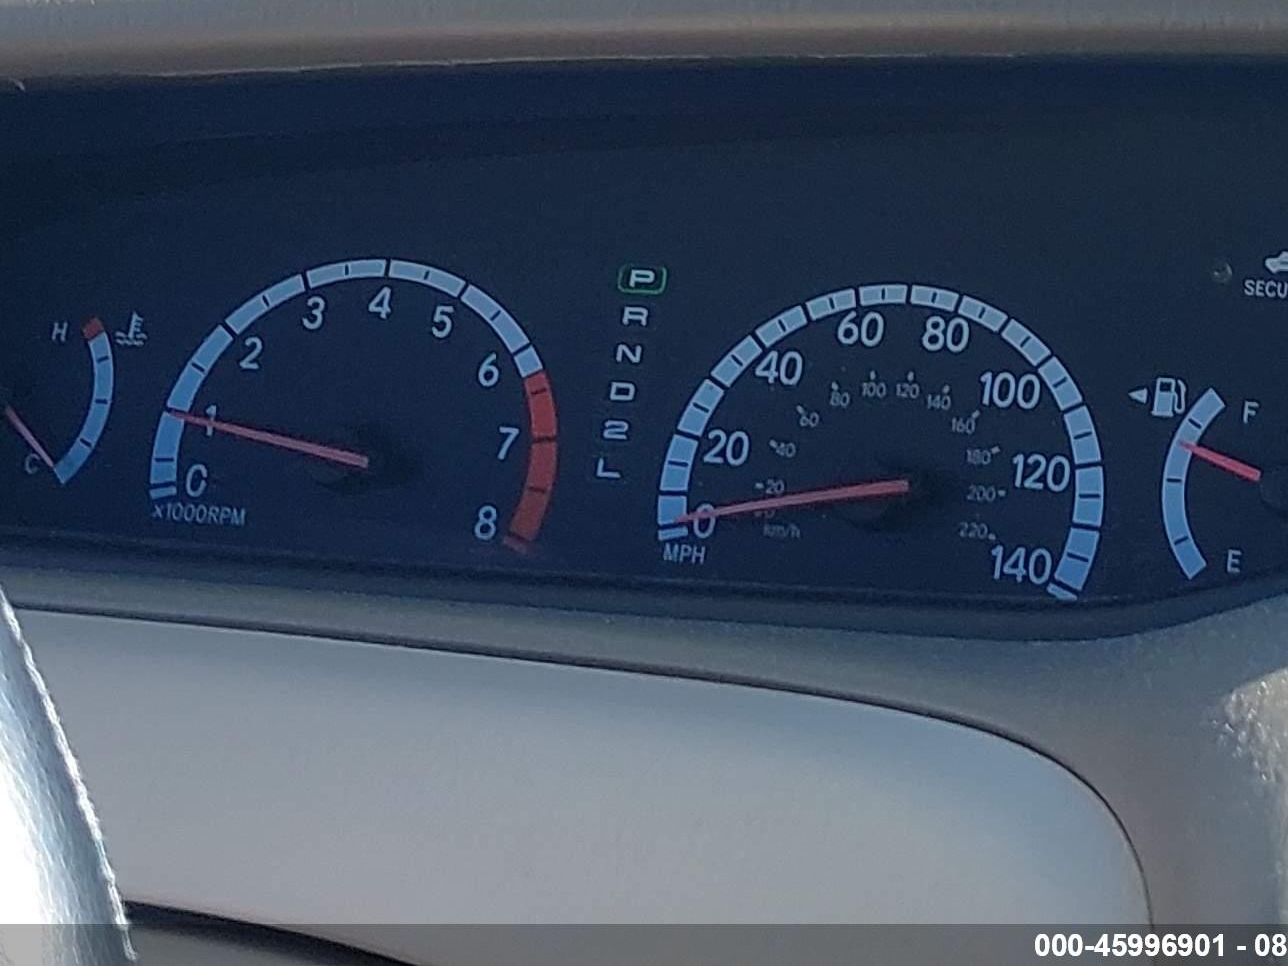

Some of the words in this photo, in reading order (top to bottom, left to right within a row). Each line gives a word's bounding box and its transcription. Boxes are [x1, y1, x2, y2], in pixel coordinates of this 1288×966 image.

[629, 269, 655, 288] P
[302, 296, 326, 330] 3
[368, 286, 392, 319] 4
[431, 305, 454, 338] 5
[622, 306, 649, 326] R
[51, 321, 68, 342] H
[836, 311, 884, 347] 60
[921, 315, 970, 352] 80
[239, 336, 263, 370] 2
[615, 344, 642, 363] N
[478, 353, 499, 387] 6
[754, 350, 803, 386] 40
[609, 381, 635, 401] D
[829, 391, 851, 408] 80
[862, 382, 887, 398] 100
[896, 383, 920, 399] 120
[979, 371, 1041, 410] 100
[927, 393, 952, 411] 140
[1243, 401, 1259, 424] F
[603, 420, 629, 440] 2
[800, 411, 821, 428] 60
[951, 417, 975, 435] 160
[498, 426, 520, 460] 7
[704, 429, 749, 466] 20
[775, 442, 797, 459] 40
[24, 453, 40, 474] C
[596, 457, 621, 478] L
[966, 448, 991, 466] 180
[1012, 453, 1070, 492] 120
[765, 479, 785, 494] 20
[966, 486, 997, 502] 200
[474, 505, 497, 539] 8
[692, 504, 716, 538] 0
[763, 523, 801, 539] km/h
[959, 521, 988, 539] 220
[663, 542, 706, 565] MPH
[991, 545, 1053, 583] 140
[1226, 549, 1242, 573] E
